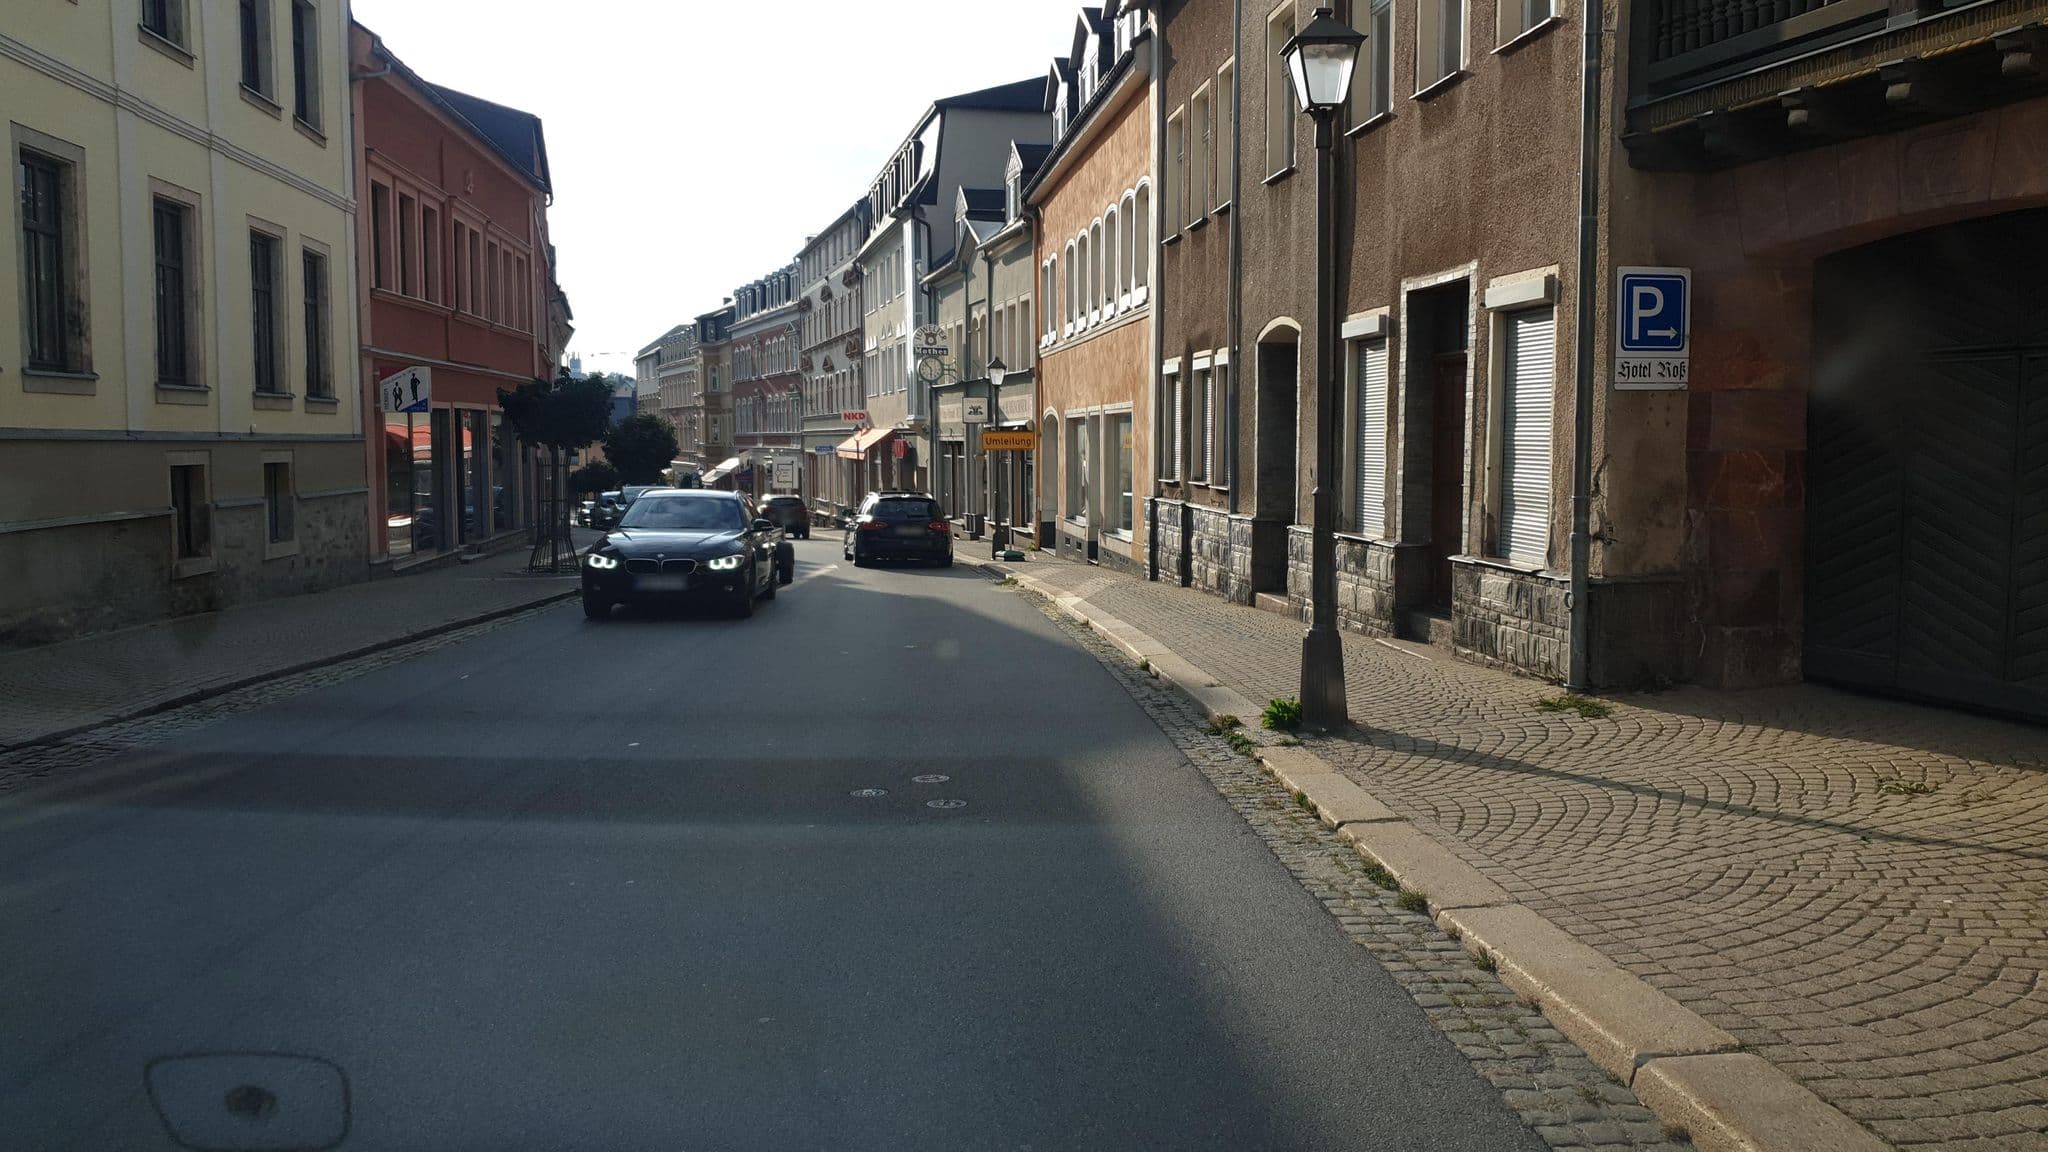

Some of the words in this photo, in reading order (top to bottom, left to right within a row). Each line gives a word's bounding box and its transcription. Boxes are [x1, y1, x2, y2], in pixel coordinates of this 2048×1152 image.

[1632, 285, 1664, 340] P
[1618, 361, 1651, 381] Hotel
[844, 412, 866, 421] NKD
[985, 436, 1032, 447] Umleitung
